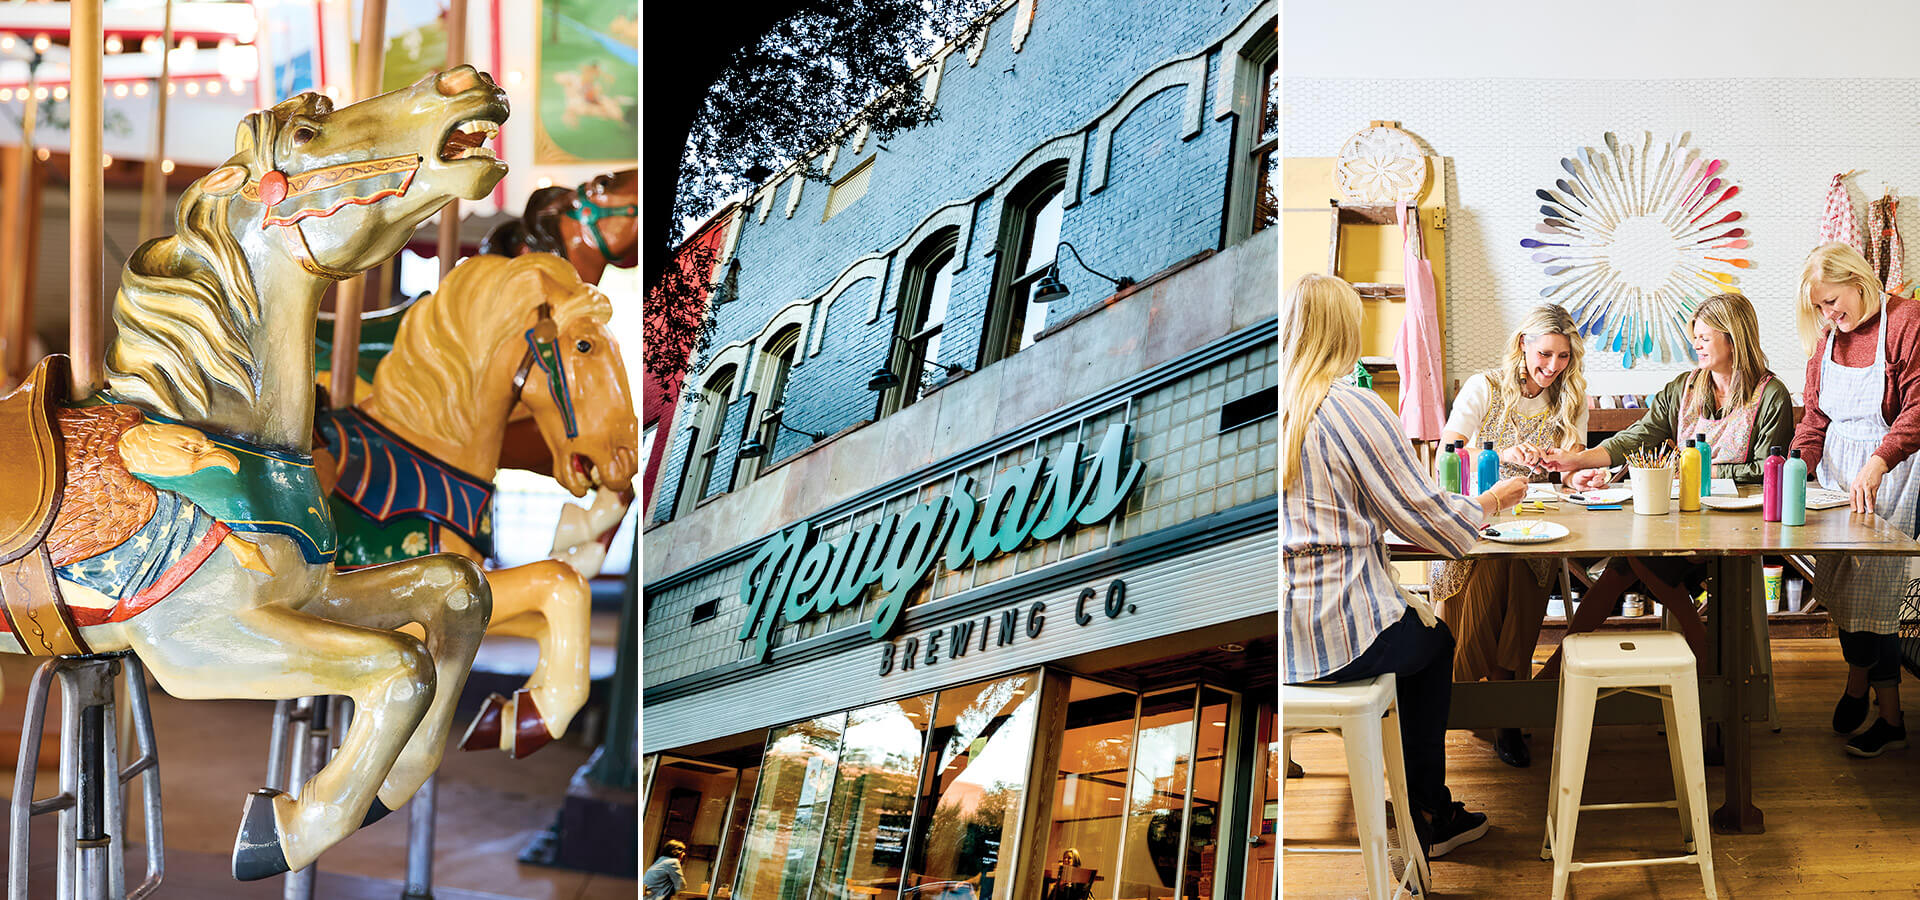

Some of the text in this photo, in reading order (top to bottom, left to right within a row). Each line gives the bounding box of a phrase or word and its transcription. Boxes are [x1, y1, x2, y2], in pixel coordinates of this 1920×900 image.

[740, 423, 1146, 664] Newgrass
[879, 579, 1136, 677] BREWING CO.
